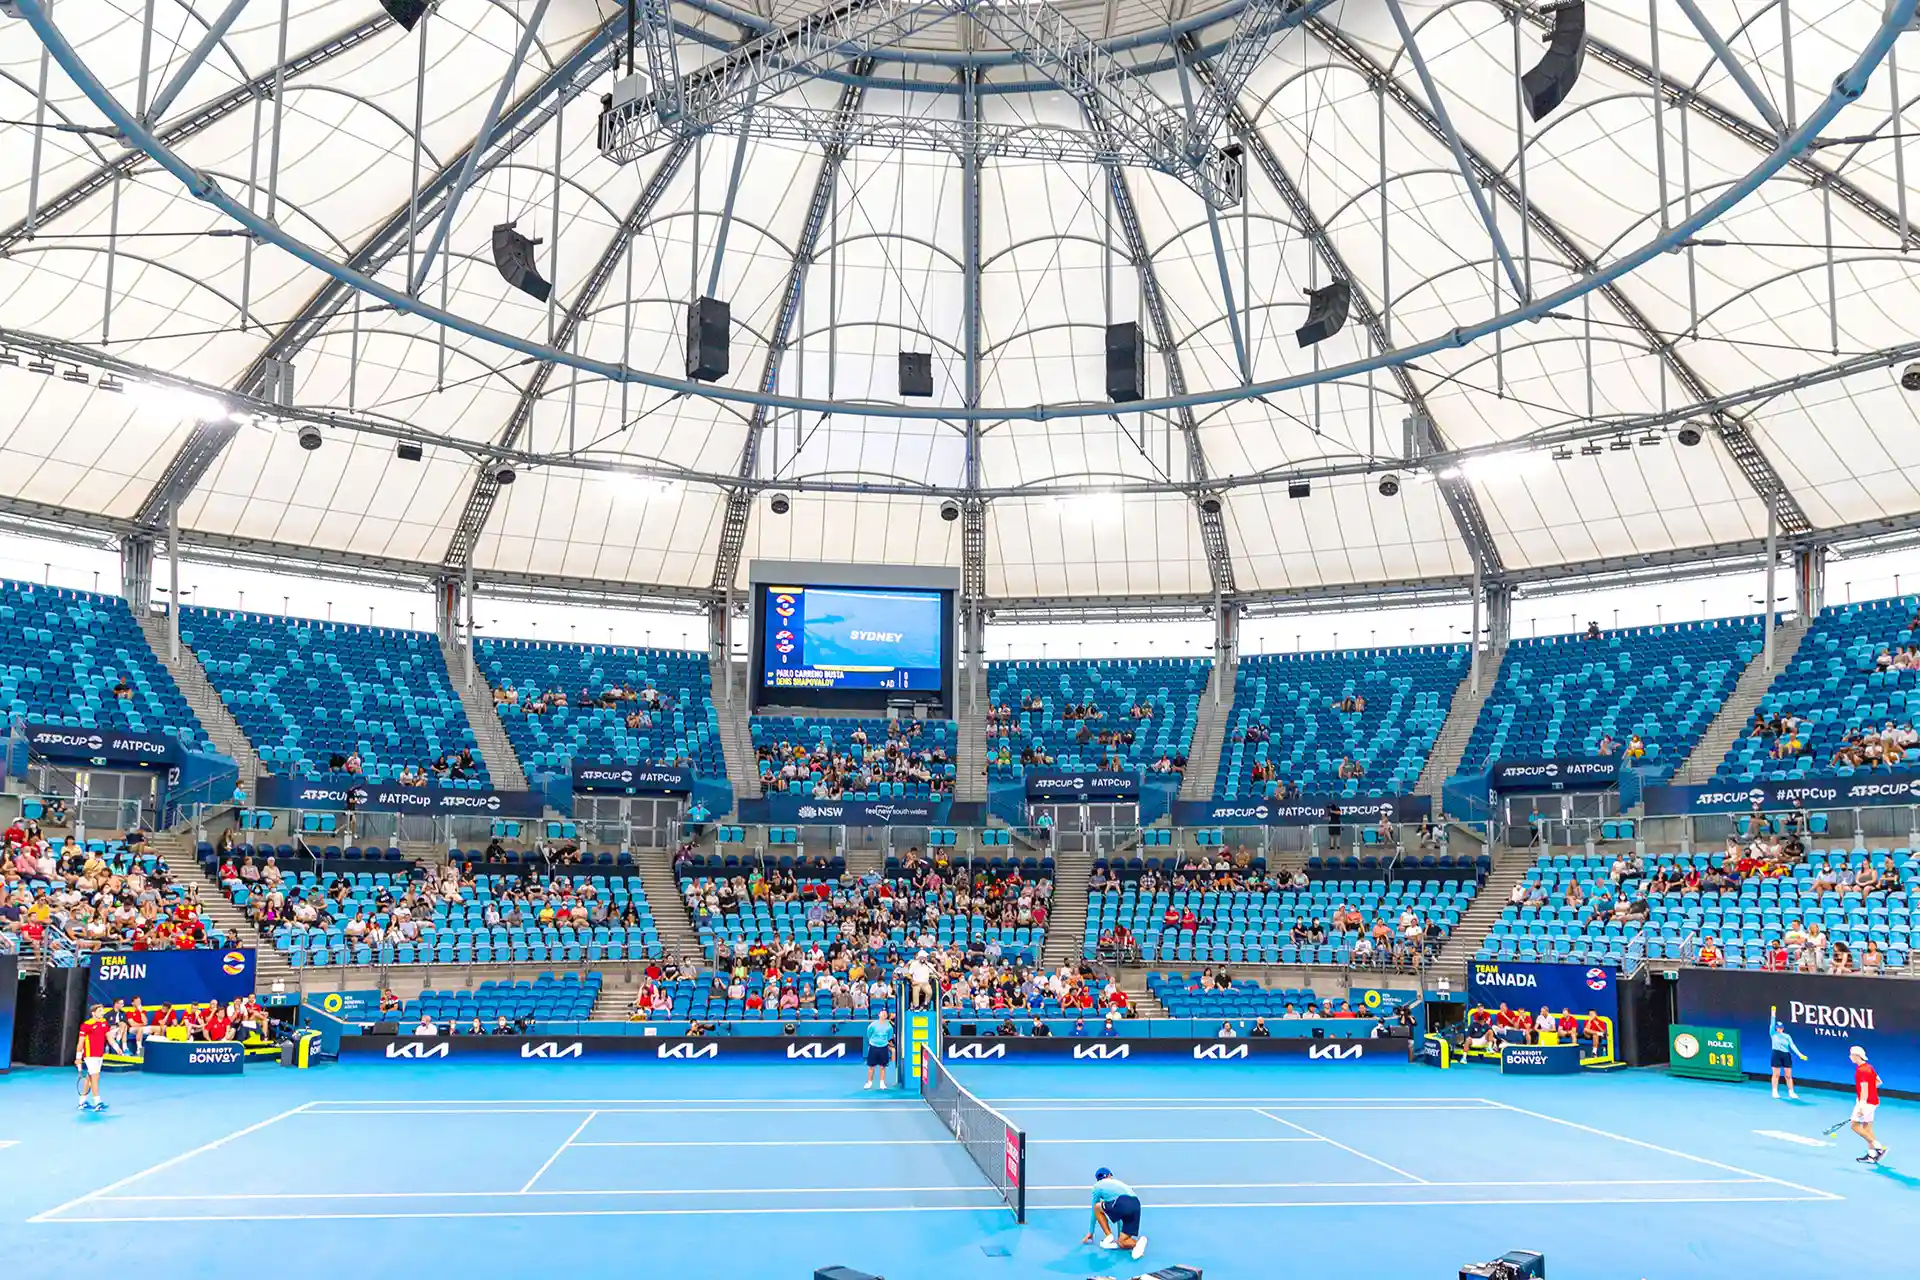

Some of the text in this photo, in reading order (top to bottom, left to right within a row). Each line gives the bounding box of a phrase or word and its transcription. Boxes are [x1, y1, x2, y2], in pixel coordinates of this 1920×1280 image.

[850, 630, 904, 643] SYDNEY
[113, 740, 165, 754] #ATPCup
[1567, 764, 1613, 773] #ATPCup
[168, 768, 180, 786] E2
[640, 773, 681, 783] #ATPCup
[1092, 779, 1131, 787] #ATPCup
[1777, 788, 1836, 800] #ATPCup
[379, 793, 430, 806] #ATPCup
[818, 808, 843, 816] NSW
[893, 808, 909, 816] south
[910, 808, 928, 816] wales
[1278, 807, 1324, 816] #ATPCup
[101, 956, 126, 965] TEAM
[100, 963, 146, 980] SPAIN
[1475, 965, 1498, 973] TEAM
[1476, 972, 1536, 987] CANADA
[1790, 1001, 1874, 1030] PERONI
[1815, 1028, 1848, 1037] ITALIA
[1708, 1039, 1733, 1048] ROLEX
[190, 1052, 238, 1063] BONVOY
[1507, 1054, 1547, 1064] BONVOY
[1709, 1053, 1733, 1066] 0:13
